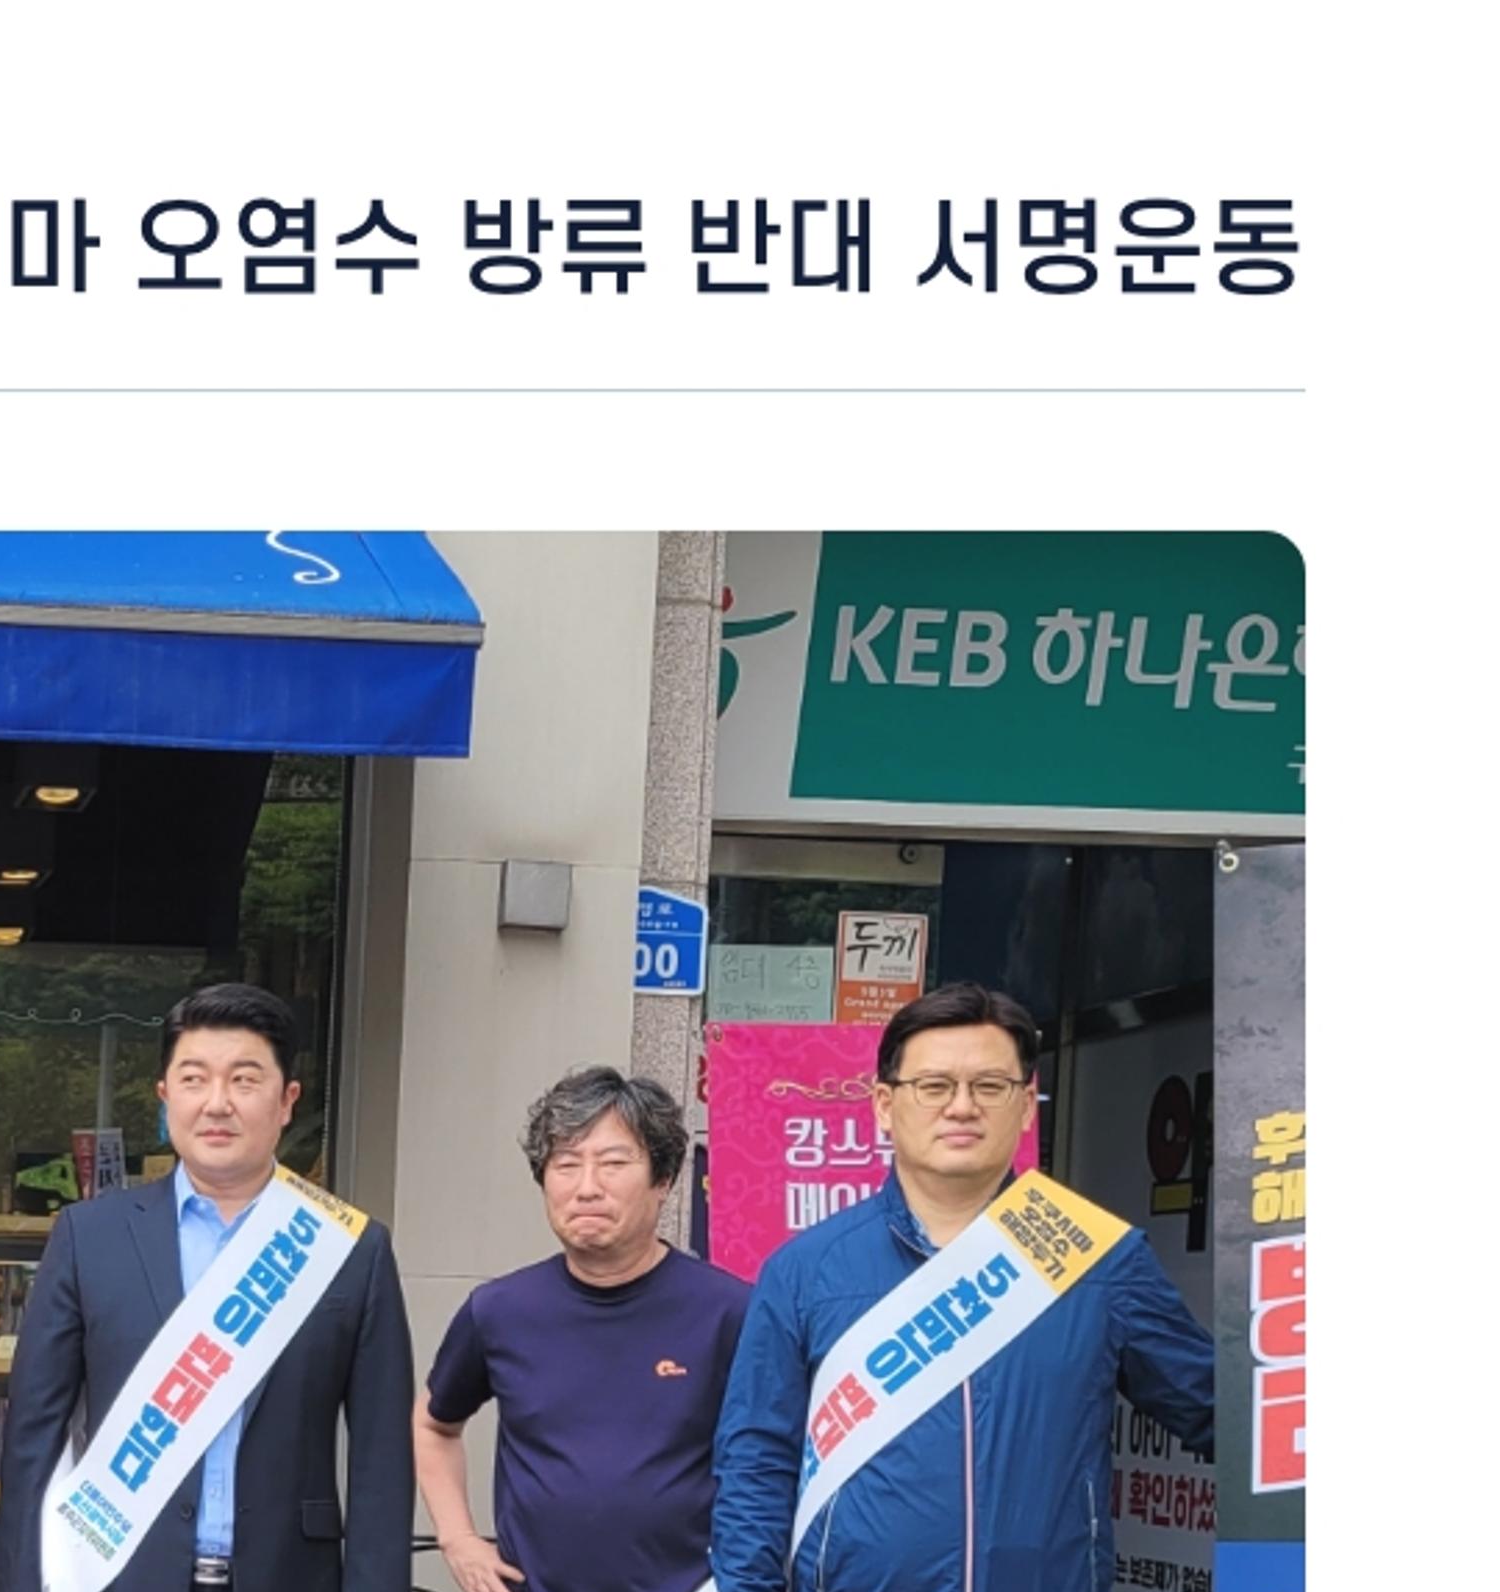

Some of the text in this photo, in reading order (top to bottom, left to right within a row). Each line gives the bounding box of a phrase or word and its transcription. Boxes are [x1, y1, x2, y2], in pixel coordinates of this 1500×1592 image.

[829, 605, 1306, 712] KEB 하나은
[213, 1205, 323, 1348] 5천만이
[866, 1251, 1021, 1396] 5천만이
[109, 1332, 235, 1493] 반대한다
